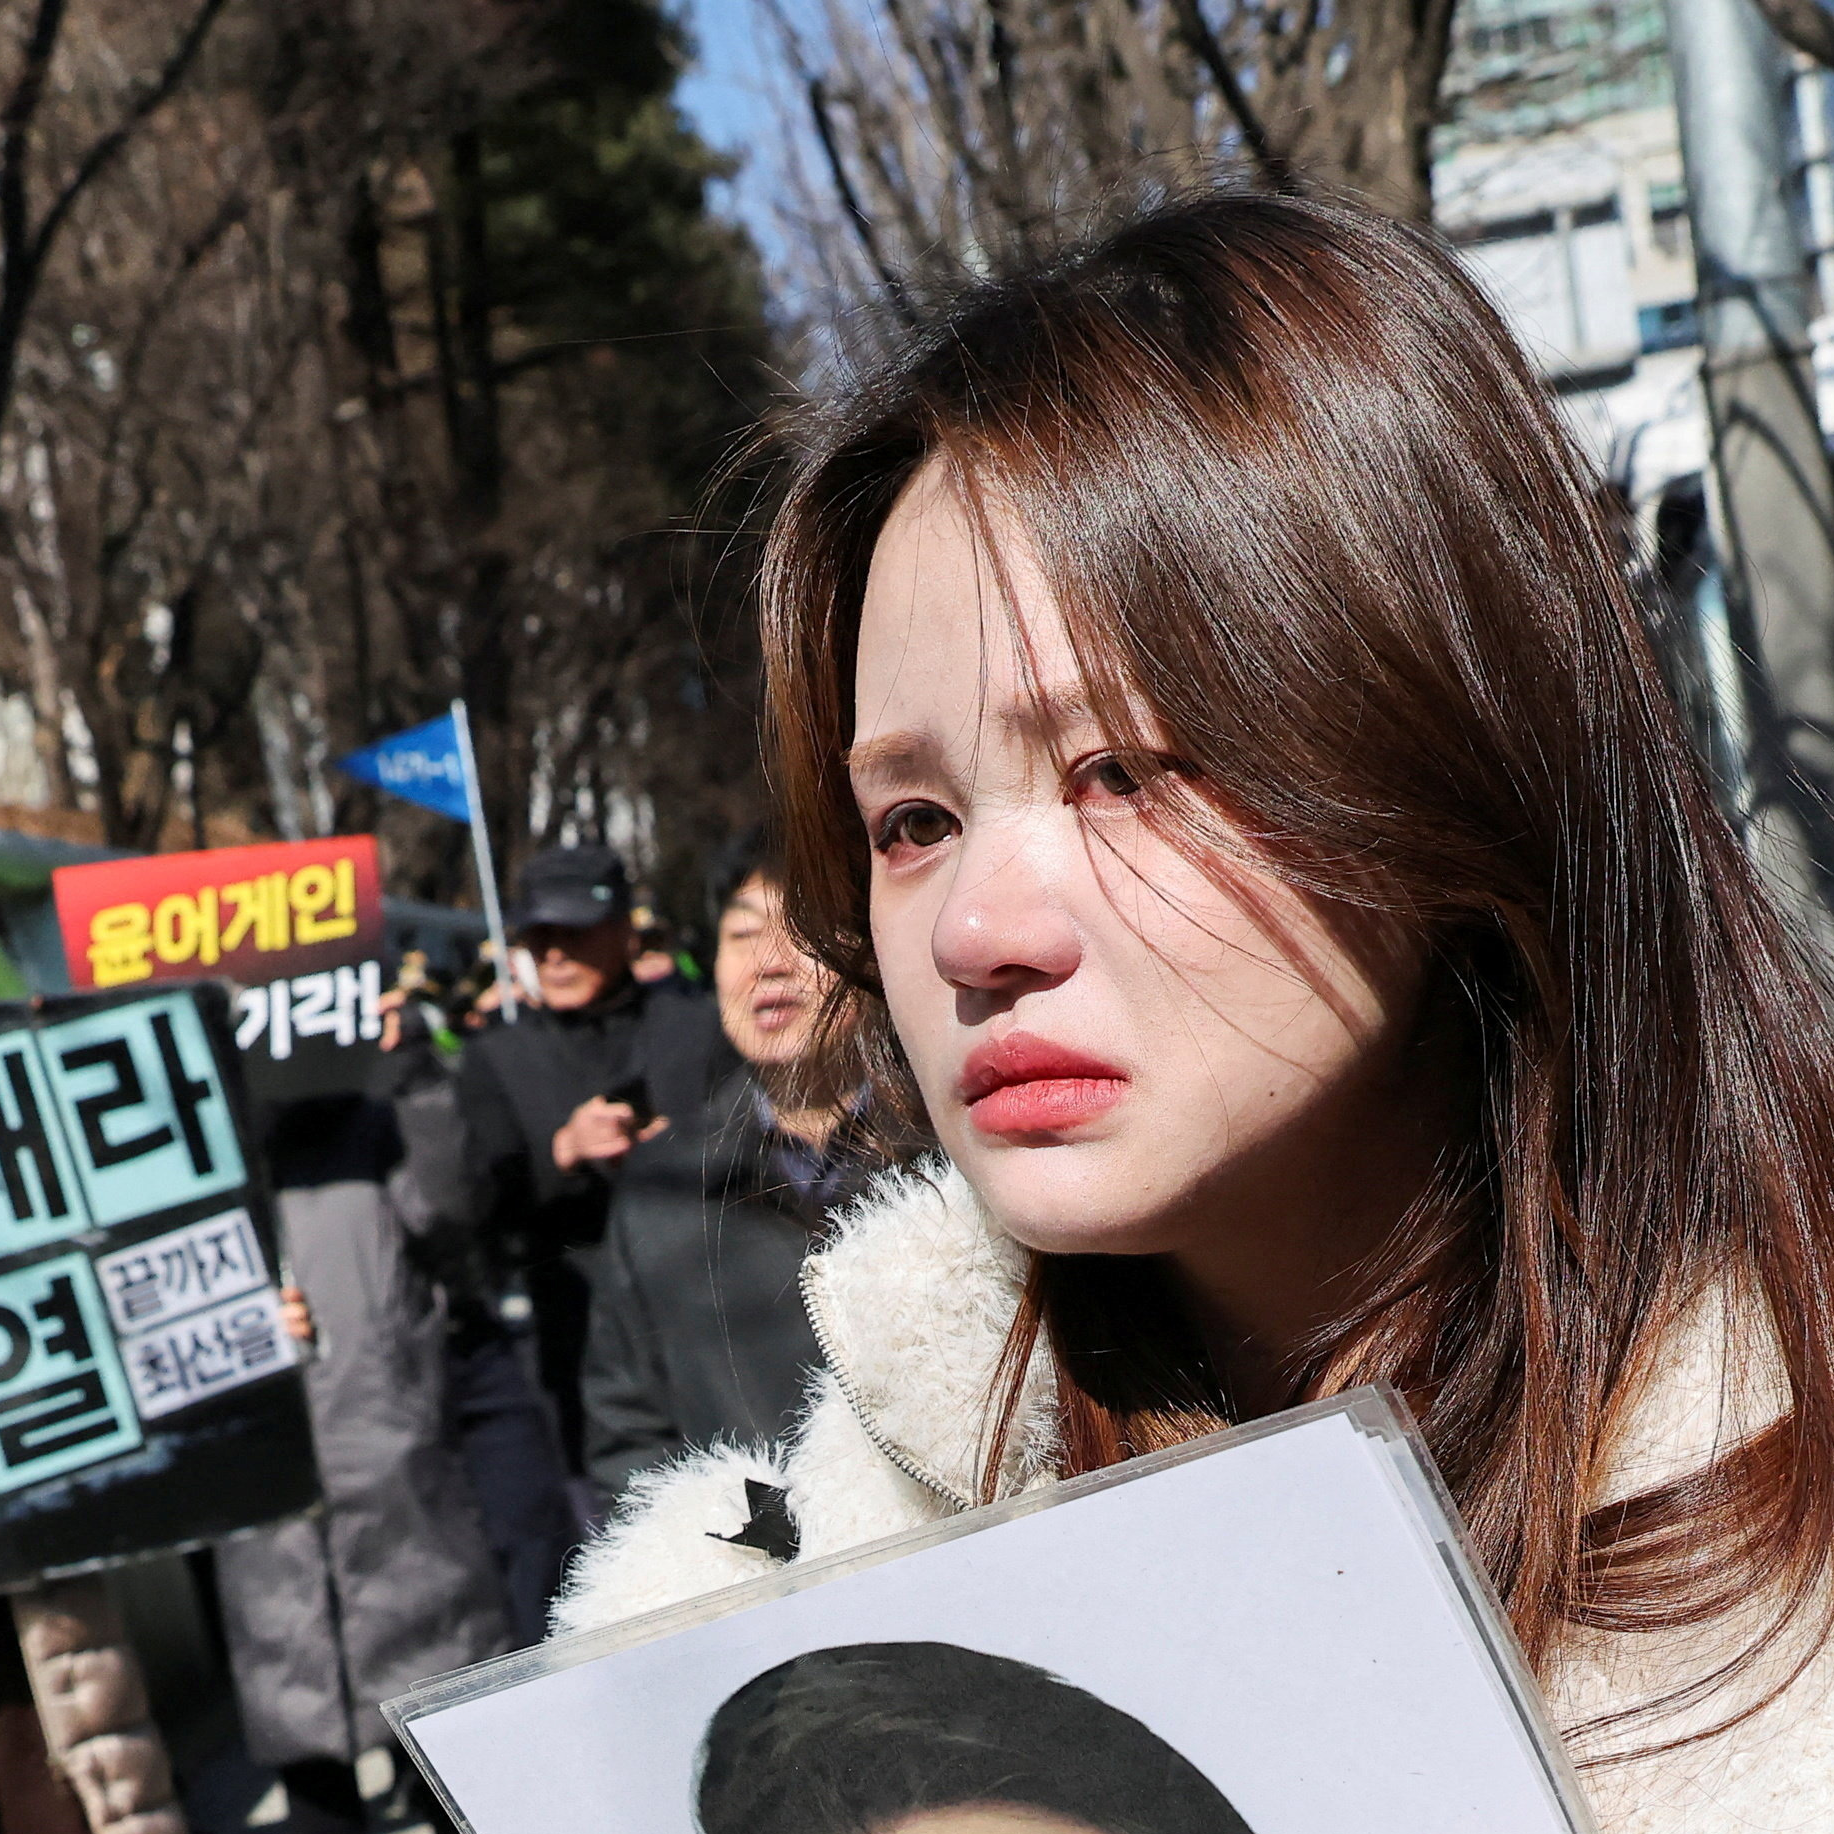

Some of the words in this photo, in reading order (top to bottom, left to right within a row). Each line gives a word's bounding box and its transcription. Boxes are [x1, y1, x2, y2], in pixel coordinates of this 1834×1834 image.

[87, 857, 358, 988] 윤어게인
[107, 1220, 259, 1320] 끝까지
[133, 1297, 281, 1401] 최선을
